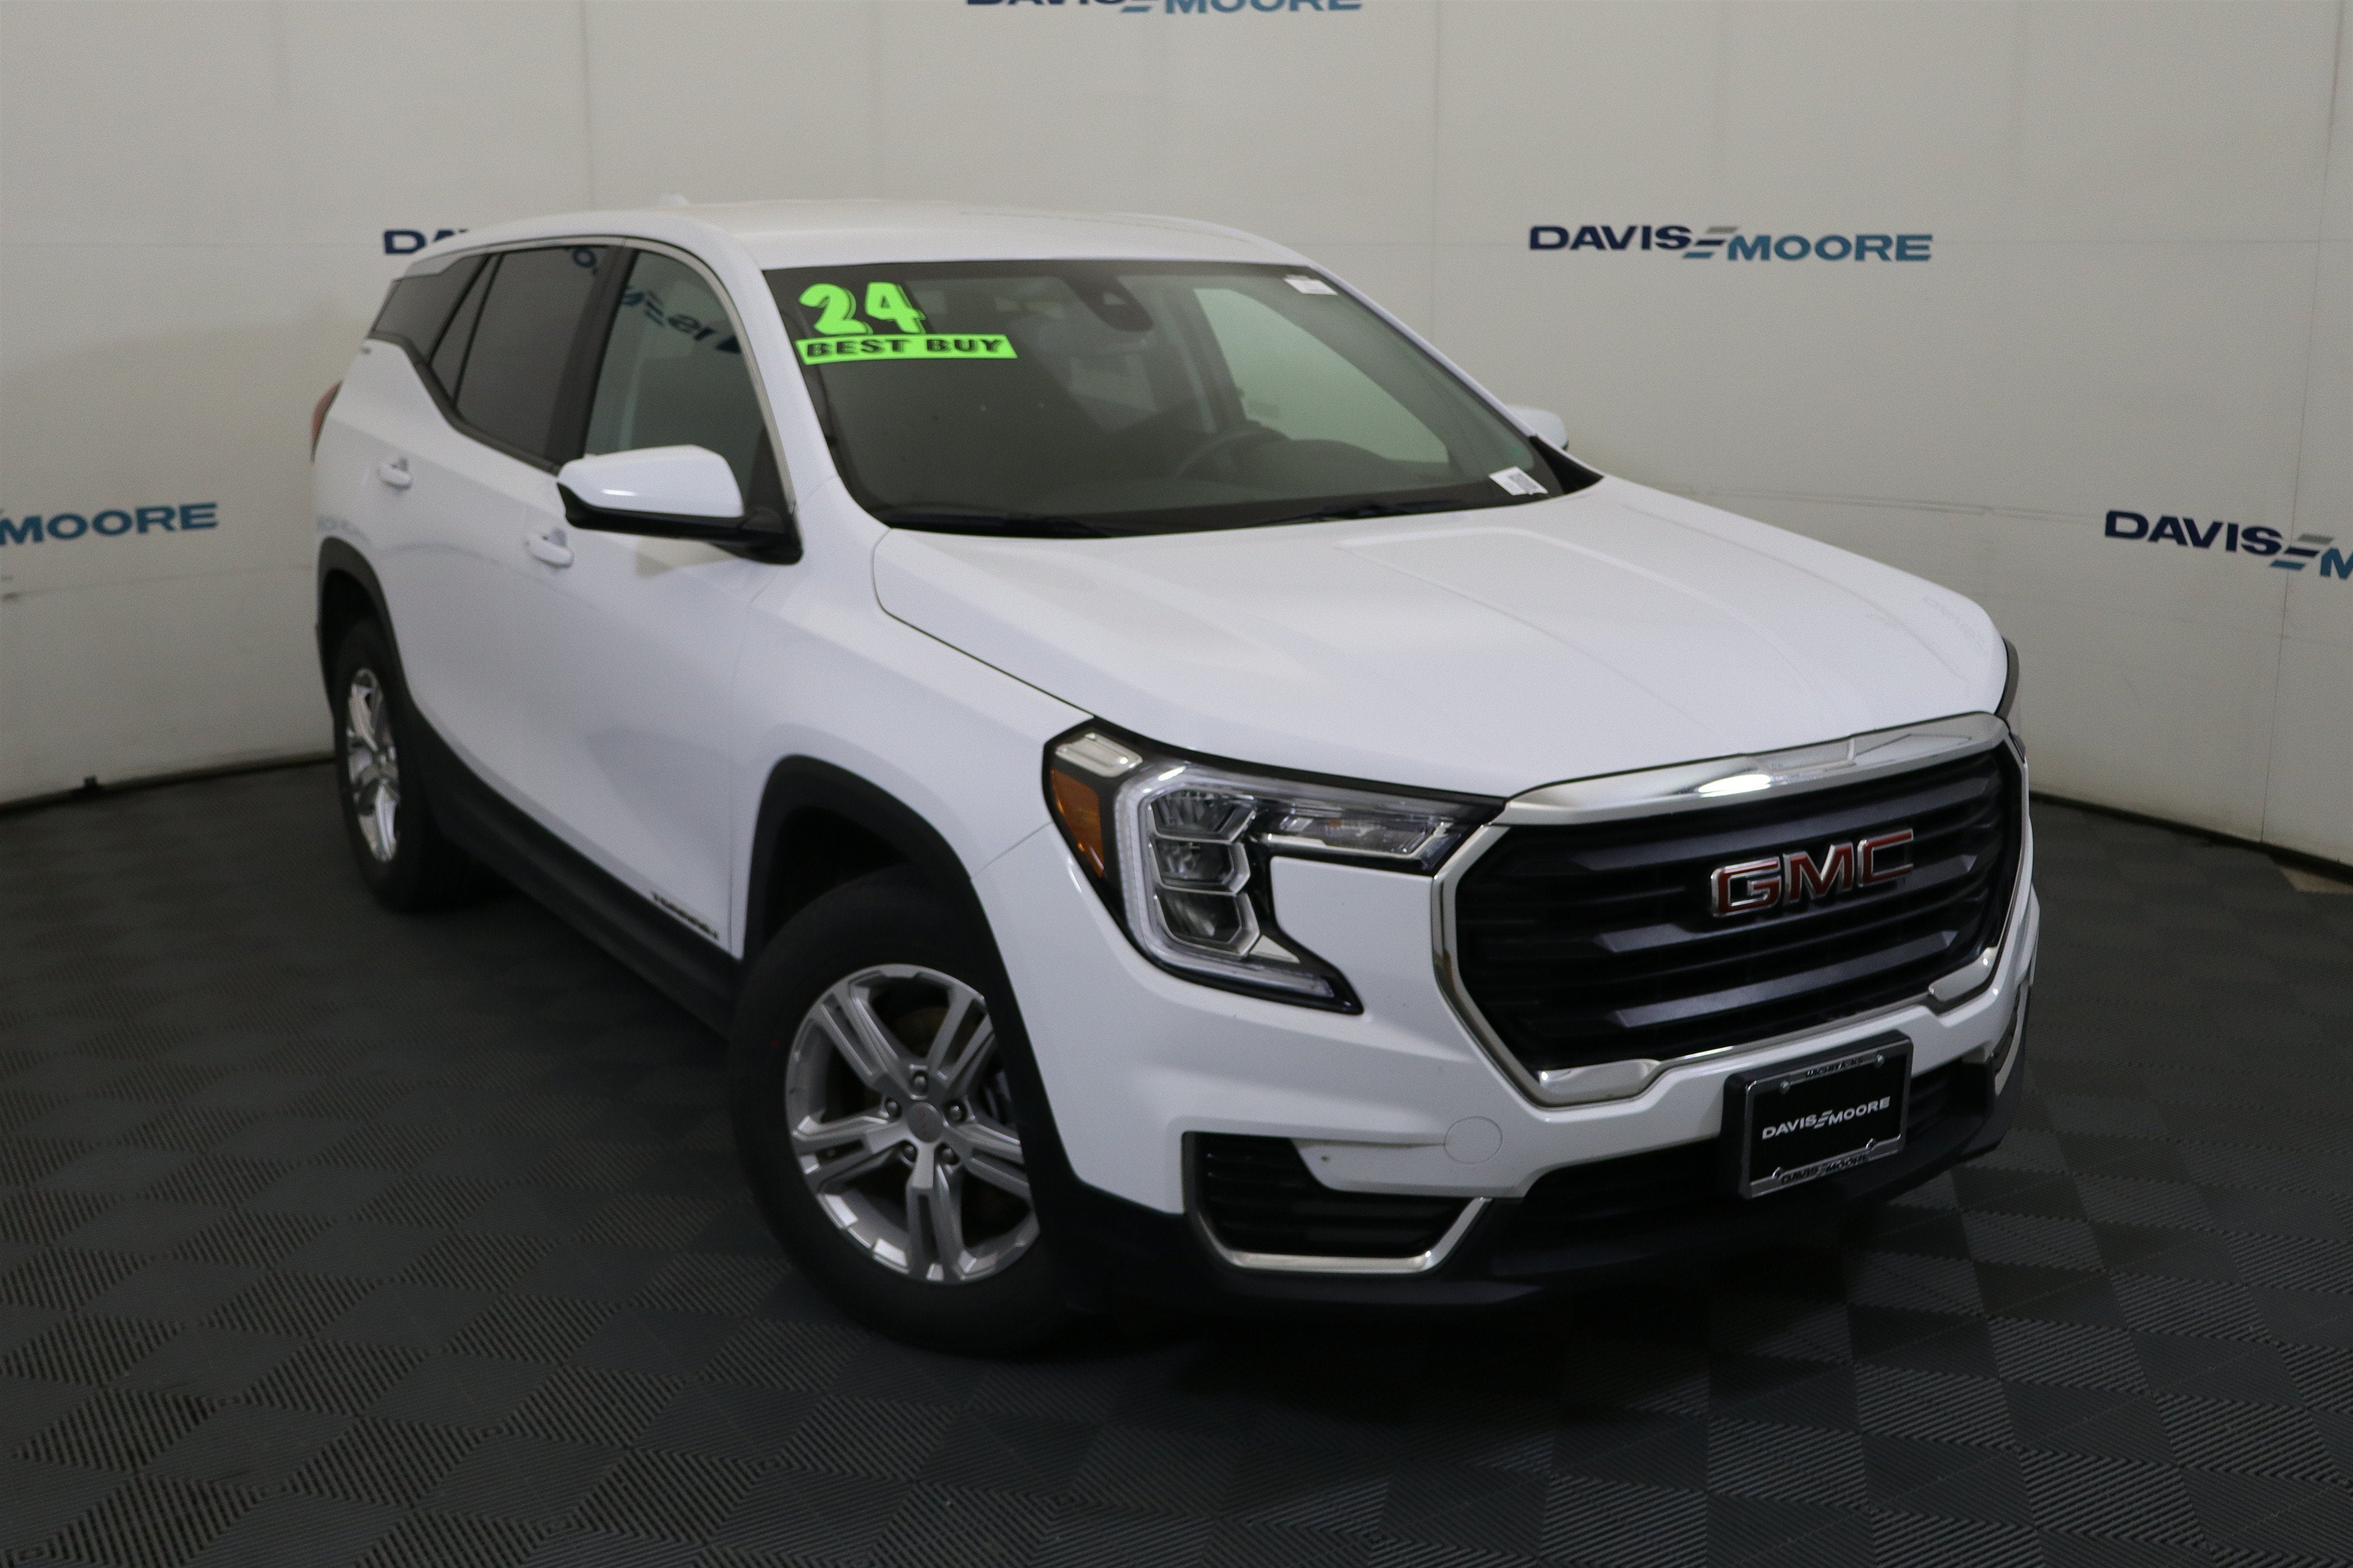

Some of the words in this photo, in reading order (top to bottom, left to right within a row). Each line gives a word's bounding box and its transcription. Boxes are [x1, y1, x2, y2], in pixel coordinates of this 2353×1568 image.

[1528, 225, 1693, 251] DAVIS
[1726, 233, 1934, 262] MOORE
[799, 281, 926, 335] 24
[807, 339, 909, 357] BEST
[925, 338, 1003, 353] BUY
[0, 501, 219, 546] MOORE
[2104, 509, 2283, 557] DAVIS
[1711, 828, 1914, 918] GMC
[1762, 1114, 1817, 1140] DAVIS
[1828, 1096, 1891, 1126] MOORE
